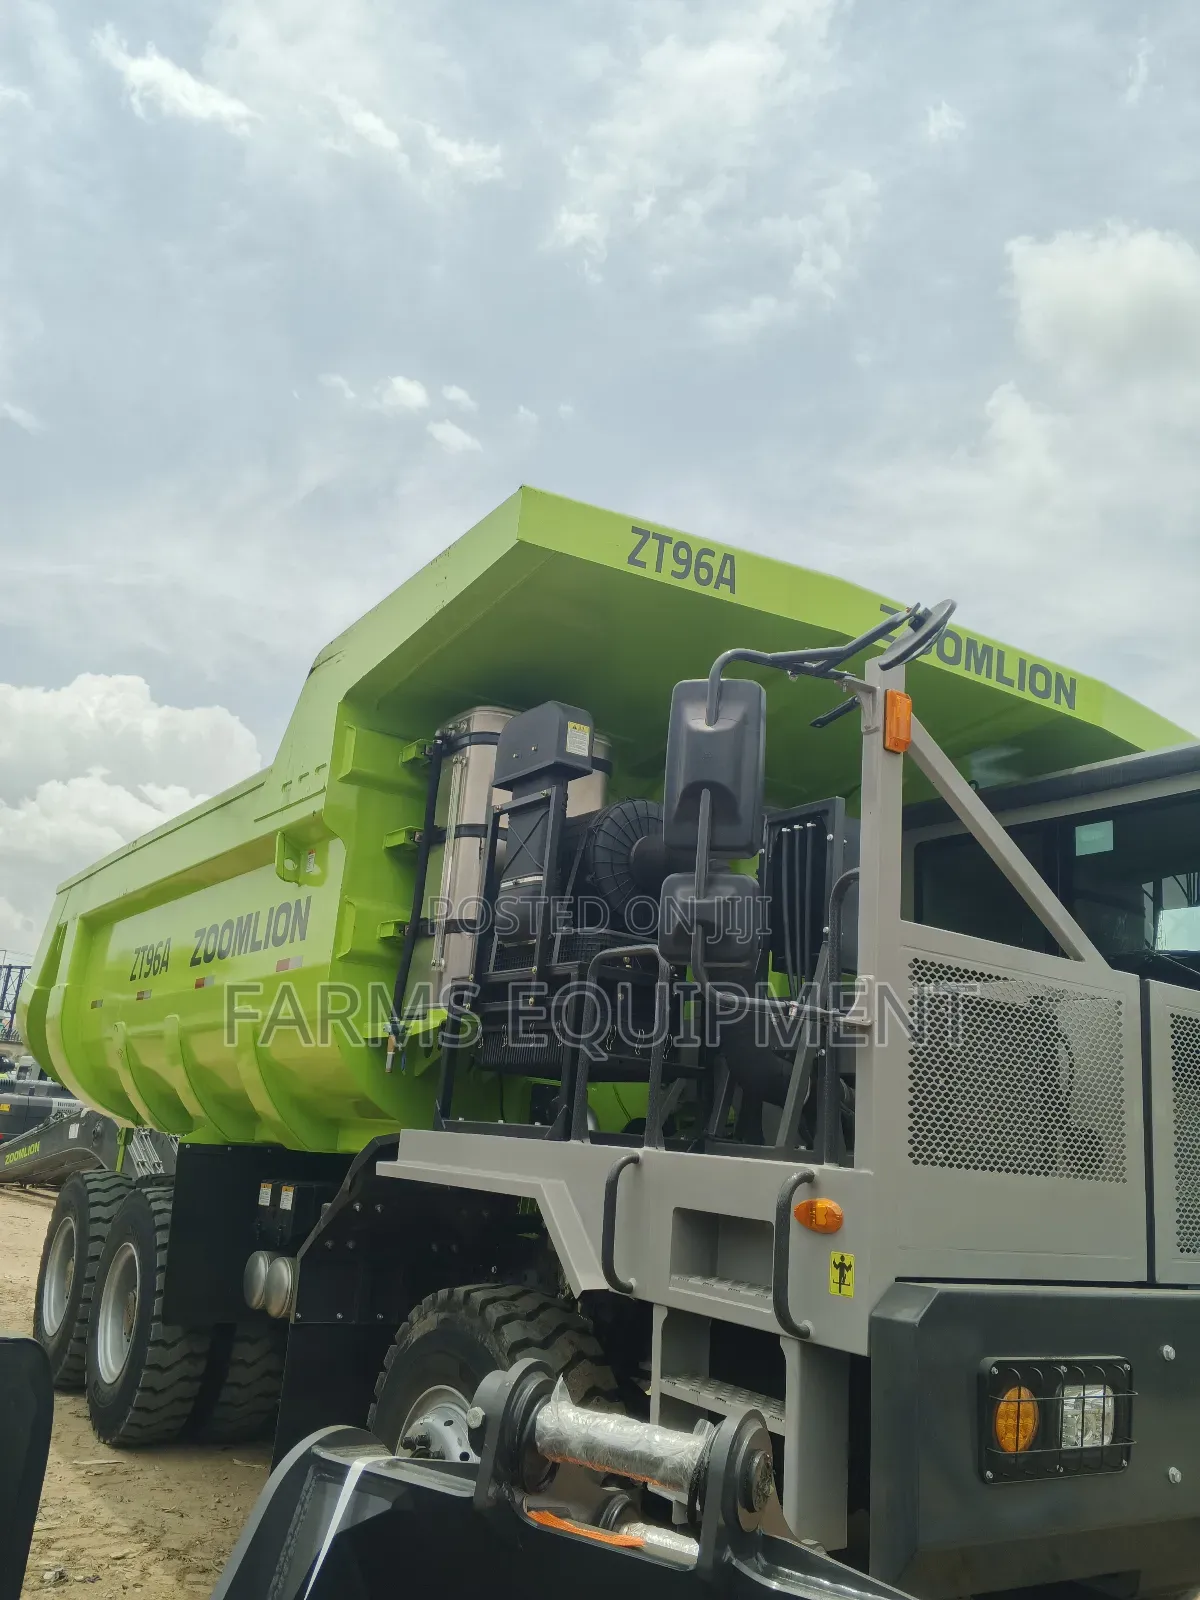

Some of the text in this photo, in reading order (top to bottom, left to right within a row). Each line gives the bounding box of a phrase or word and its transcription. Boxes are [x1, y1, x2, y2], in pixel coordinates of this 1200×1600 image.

[627, 525, 736, 595] ZT96A
[880, 603, 1077, 711] OMLION
[129, 896, 312, 982] ZT96A ZOOMLION
[4, 1141, 41, 1165] ZOOMLION
